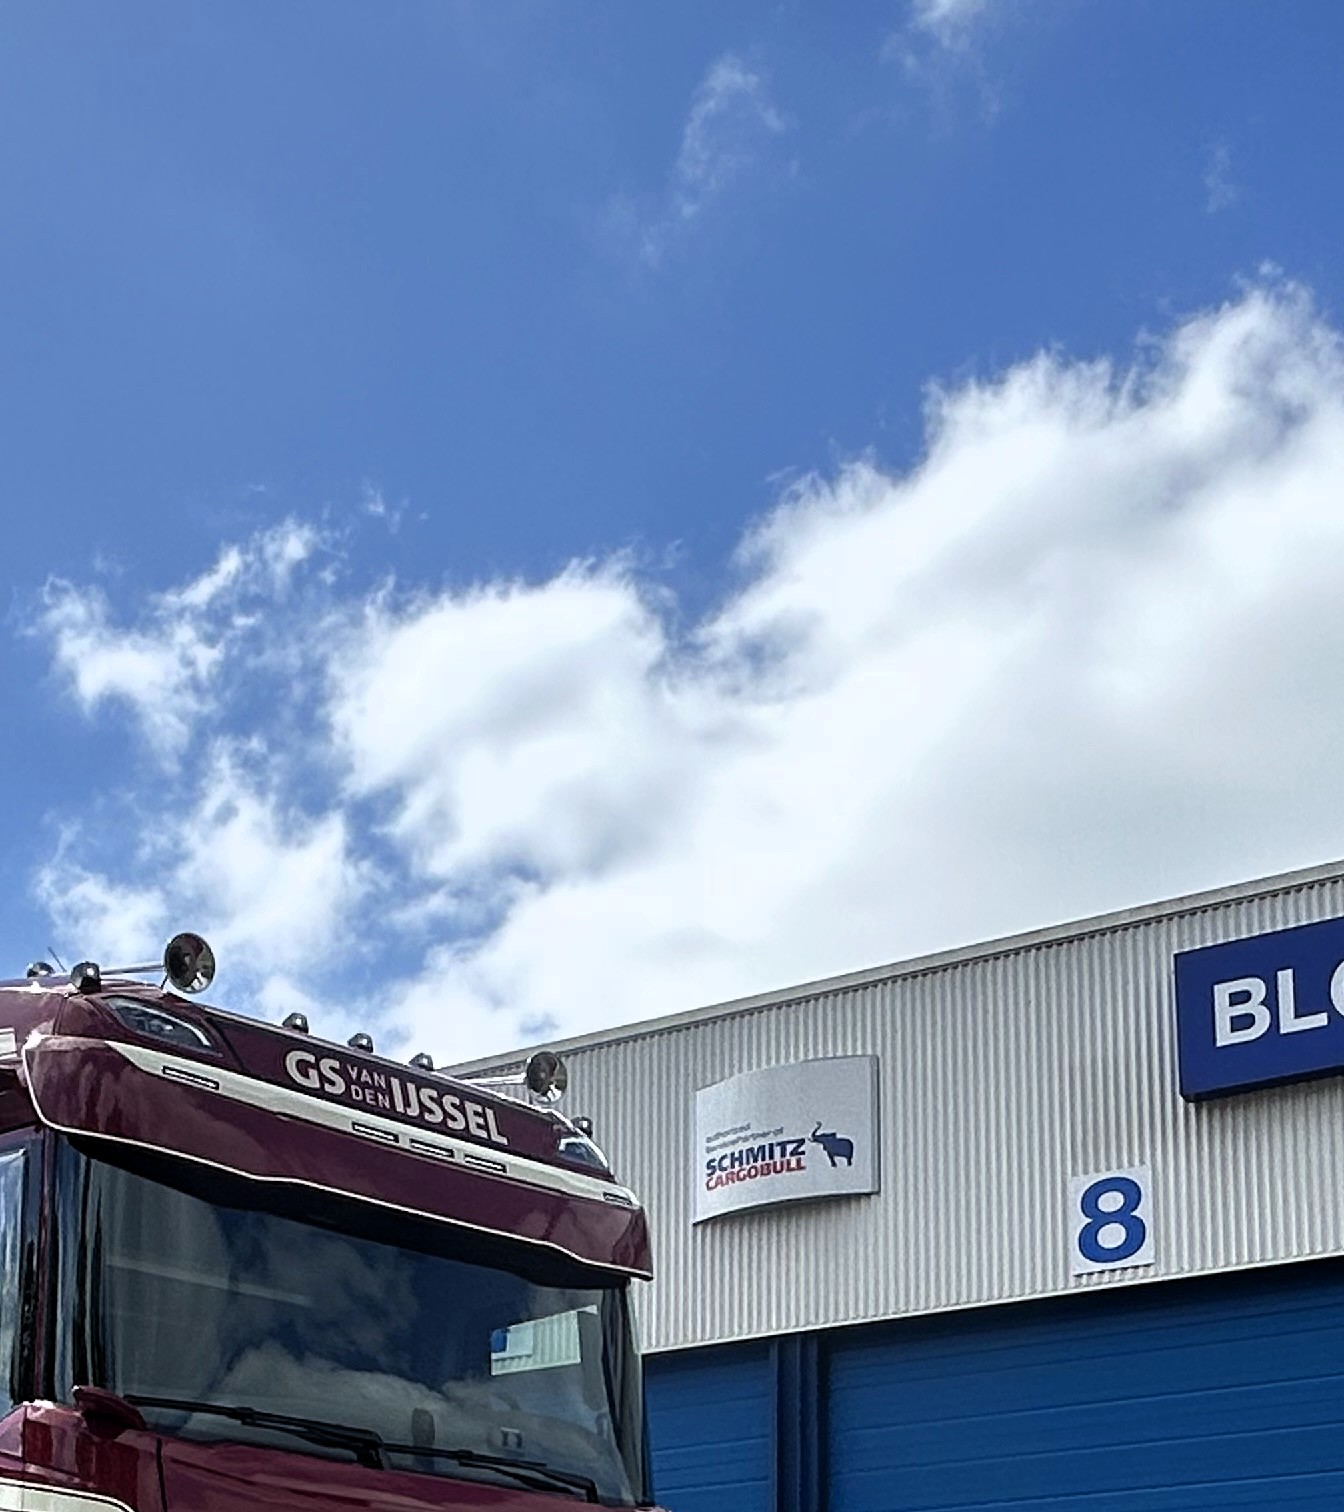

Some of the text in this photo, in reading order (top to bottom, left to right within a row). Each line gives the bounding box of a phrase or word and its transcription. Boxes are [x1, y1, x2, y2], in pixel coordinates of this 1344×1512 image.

[285, 1049, 509, 1146] GS VAN DEN IJSSEL
[705, 1137, 806, 1178] SCHMITZ
[706, 1156, 807, 1192] CARGOBULL
[1077, 1175, 1147, 1264] 8
